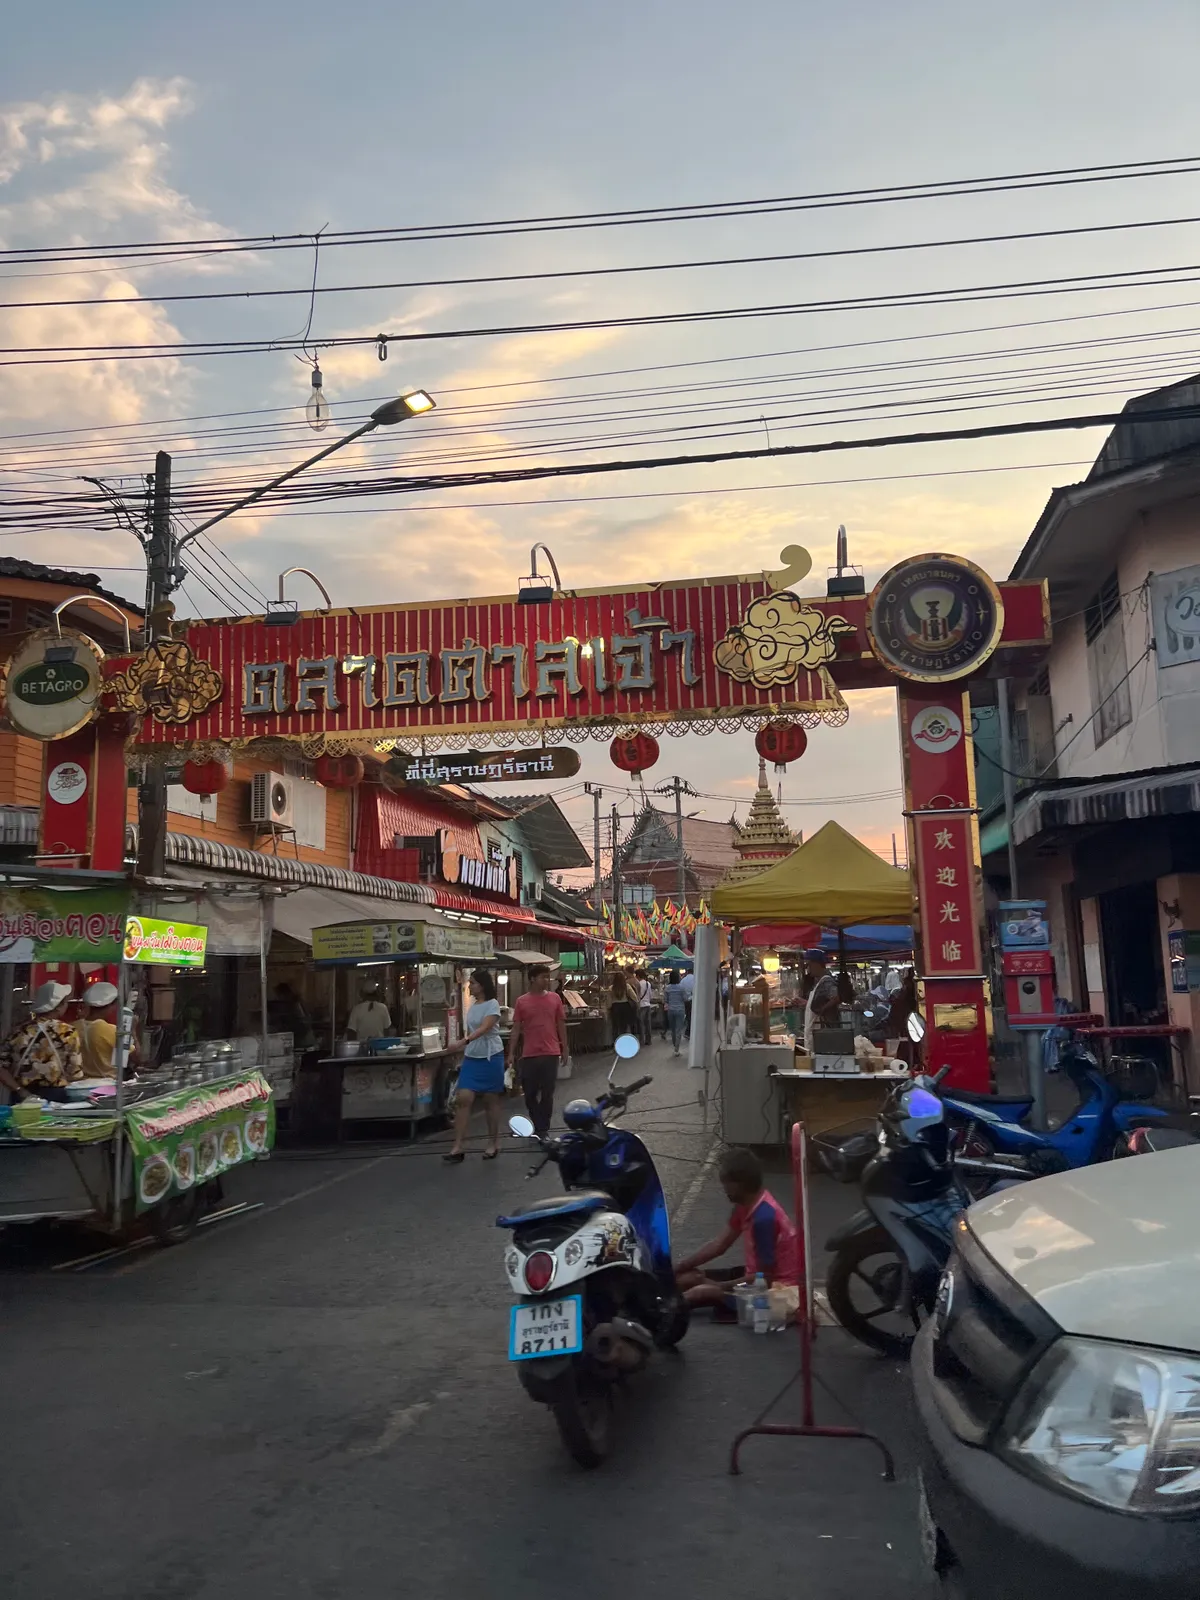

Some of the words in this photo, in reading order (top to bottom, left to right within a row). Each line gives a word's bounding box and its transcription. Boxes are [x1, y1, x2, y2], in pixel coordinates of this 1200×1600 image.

[241, 608, 701, 714] ตลาดศาลเจ้า
[21, 679, 84, 694] BETAGRO
[405, 754, 555, 782] ที่นี่สุราษฎร์ธานี
[461, 856, 485, 889] NOBI
[933, 827, 962, 962] 欢迎光临
[0, 911, 123, 945] นเมืองคอน
[521, 1336, 568, 1355] 8711
